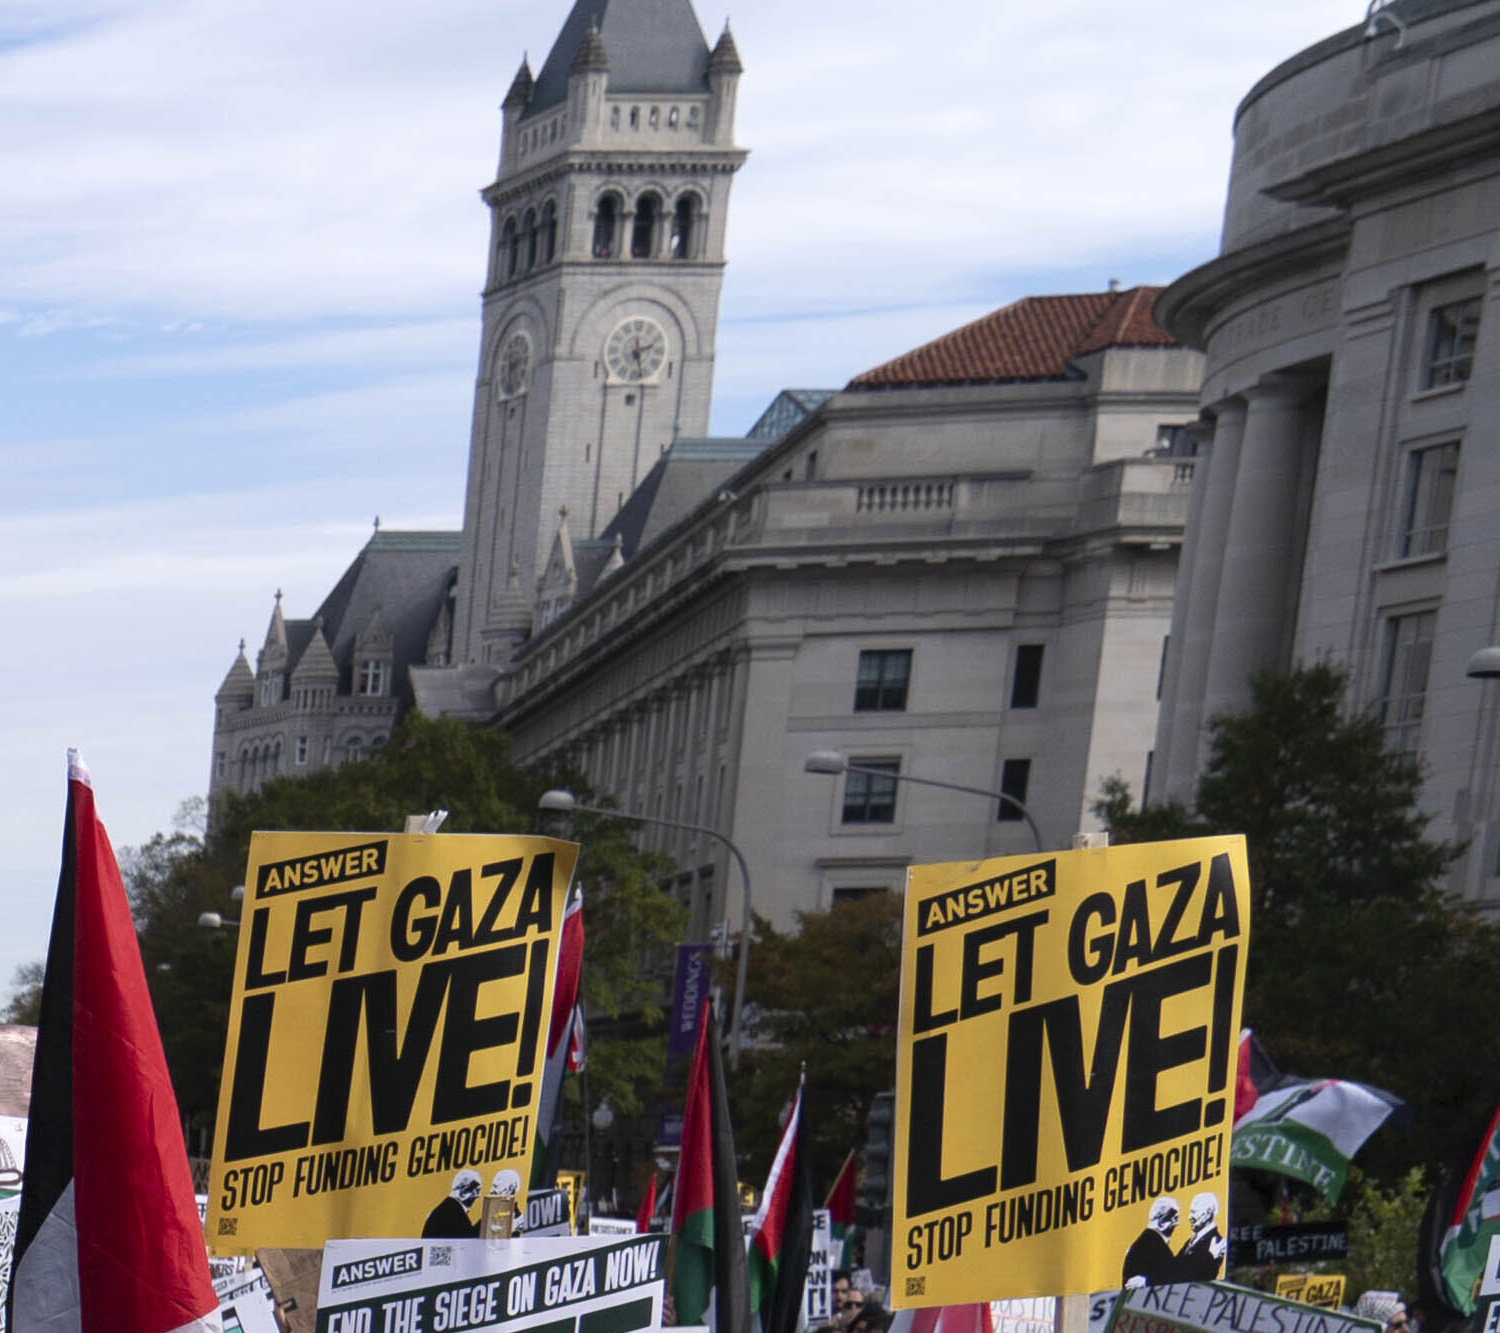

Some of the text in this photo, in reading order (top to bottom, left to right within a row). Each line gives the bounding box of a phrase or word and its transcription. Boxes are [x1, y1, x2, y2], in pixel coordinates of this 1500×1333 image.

[244, 853, 556, 990] LET GAZA
[263, 848, 379, 891] ANSWER
[913, 853, 1241, 1035] LET GAZA
[223, 939, 550, 1163] LIVE!
[905, 943, 1238, 1219] LIVE!
[221, 1116, 528, 1211] STOP FUNDING GENOCIDE!
